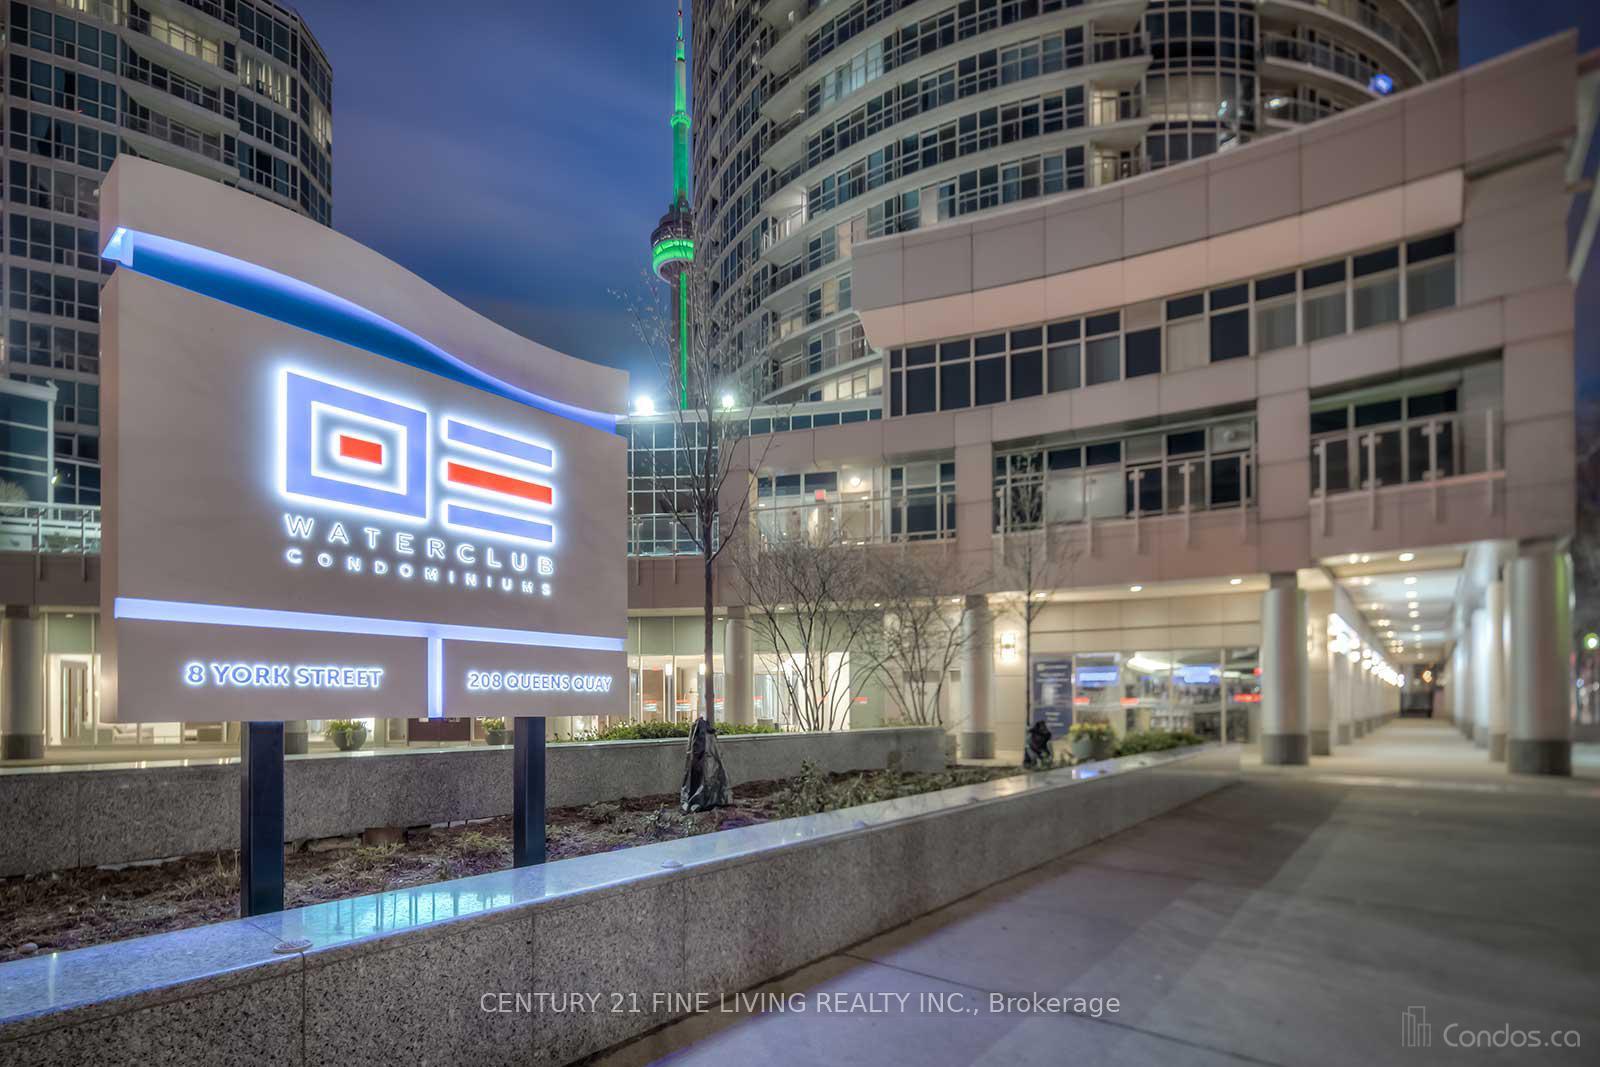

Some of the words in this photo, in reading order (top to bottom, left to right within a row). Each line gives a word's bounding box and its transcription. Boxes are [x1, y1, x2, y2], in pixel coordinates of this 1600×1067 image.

[284, 513, 555, 575] WATERCLUB
[286, 549, 552, 596] CONDOMINIUMS
[185, 664, 205, 686] 8
[212, 664, 290, 687] YORK
[295, 667, 384, 688] STREET
[467, 672, 502, 690] 208
[505, 674, 571, 691] QUEENS
[572, 676, 612, 693] QUAY
